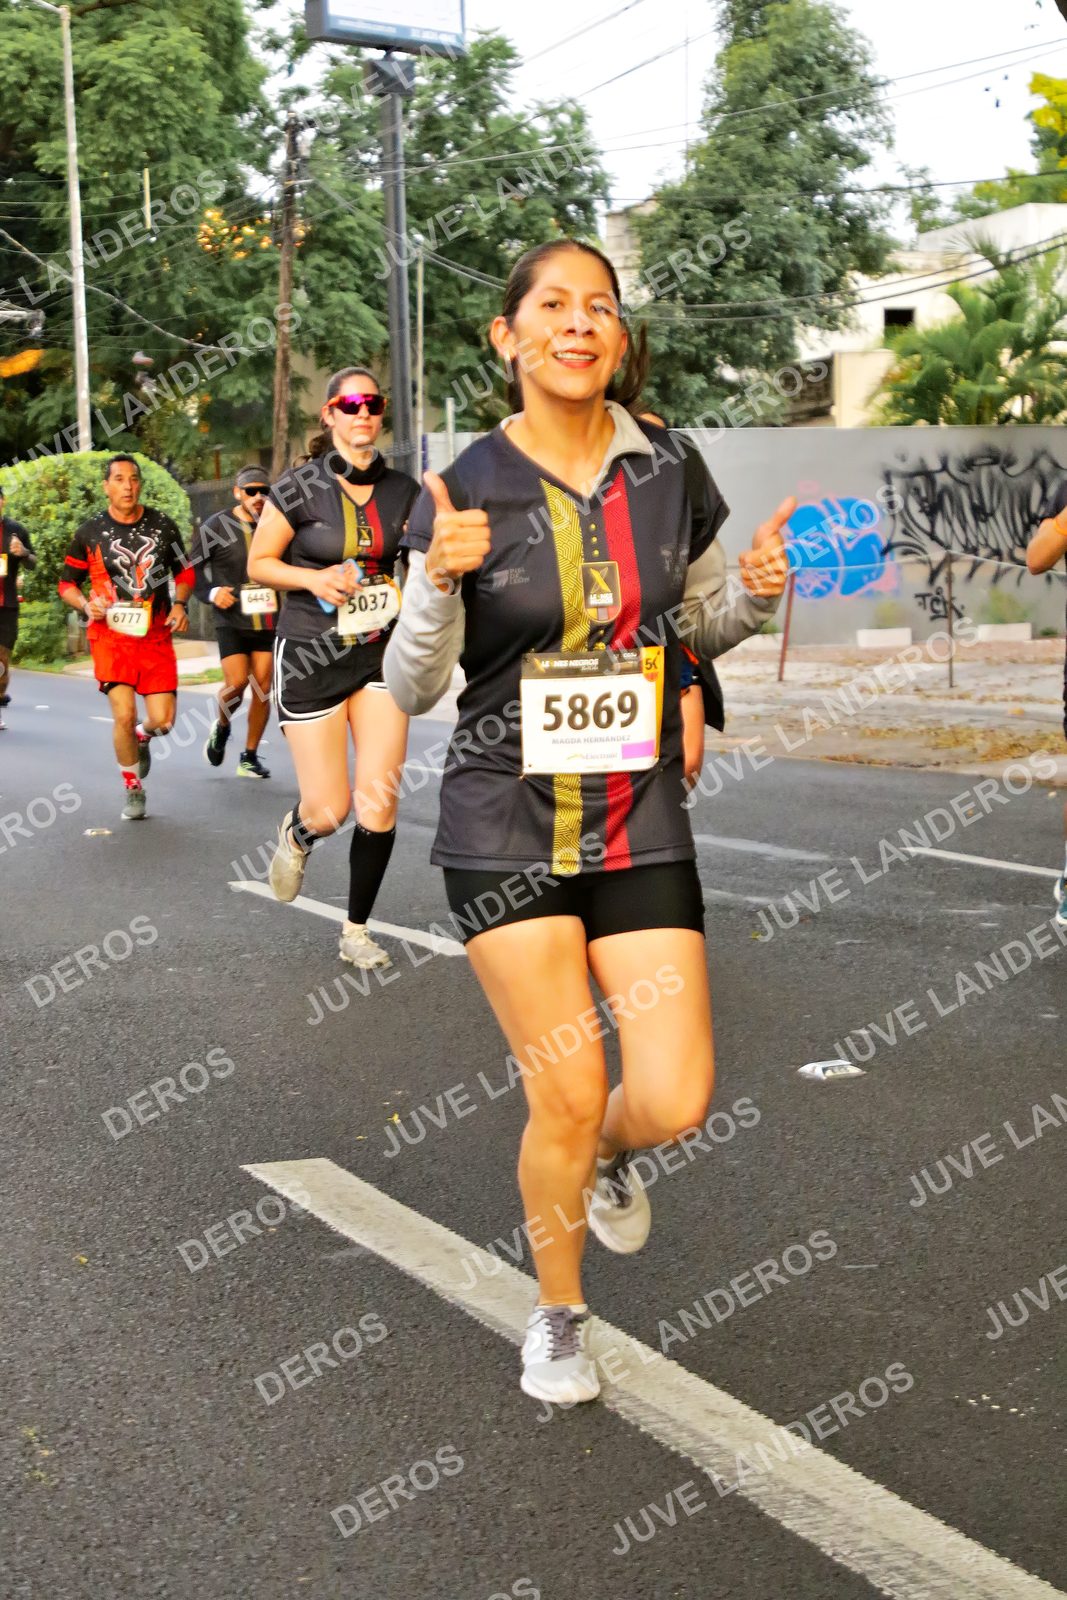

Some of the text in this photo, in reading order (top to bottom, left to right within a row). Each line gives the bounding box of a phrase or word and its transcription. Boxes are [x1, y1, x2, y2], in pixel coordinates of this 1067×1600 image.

[247, 592, 271, 603] 6445
[348, 592, 388, 614] 5037
[113, 612, 142, 623] 6777
[543, 689, 639, 731] 5869
